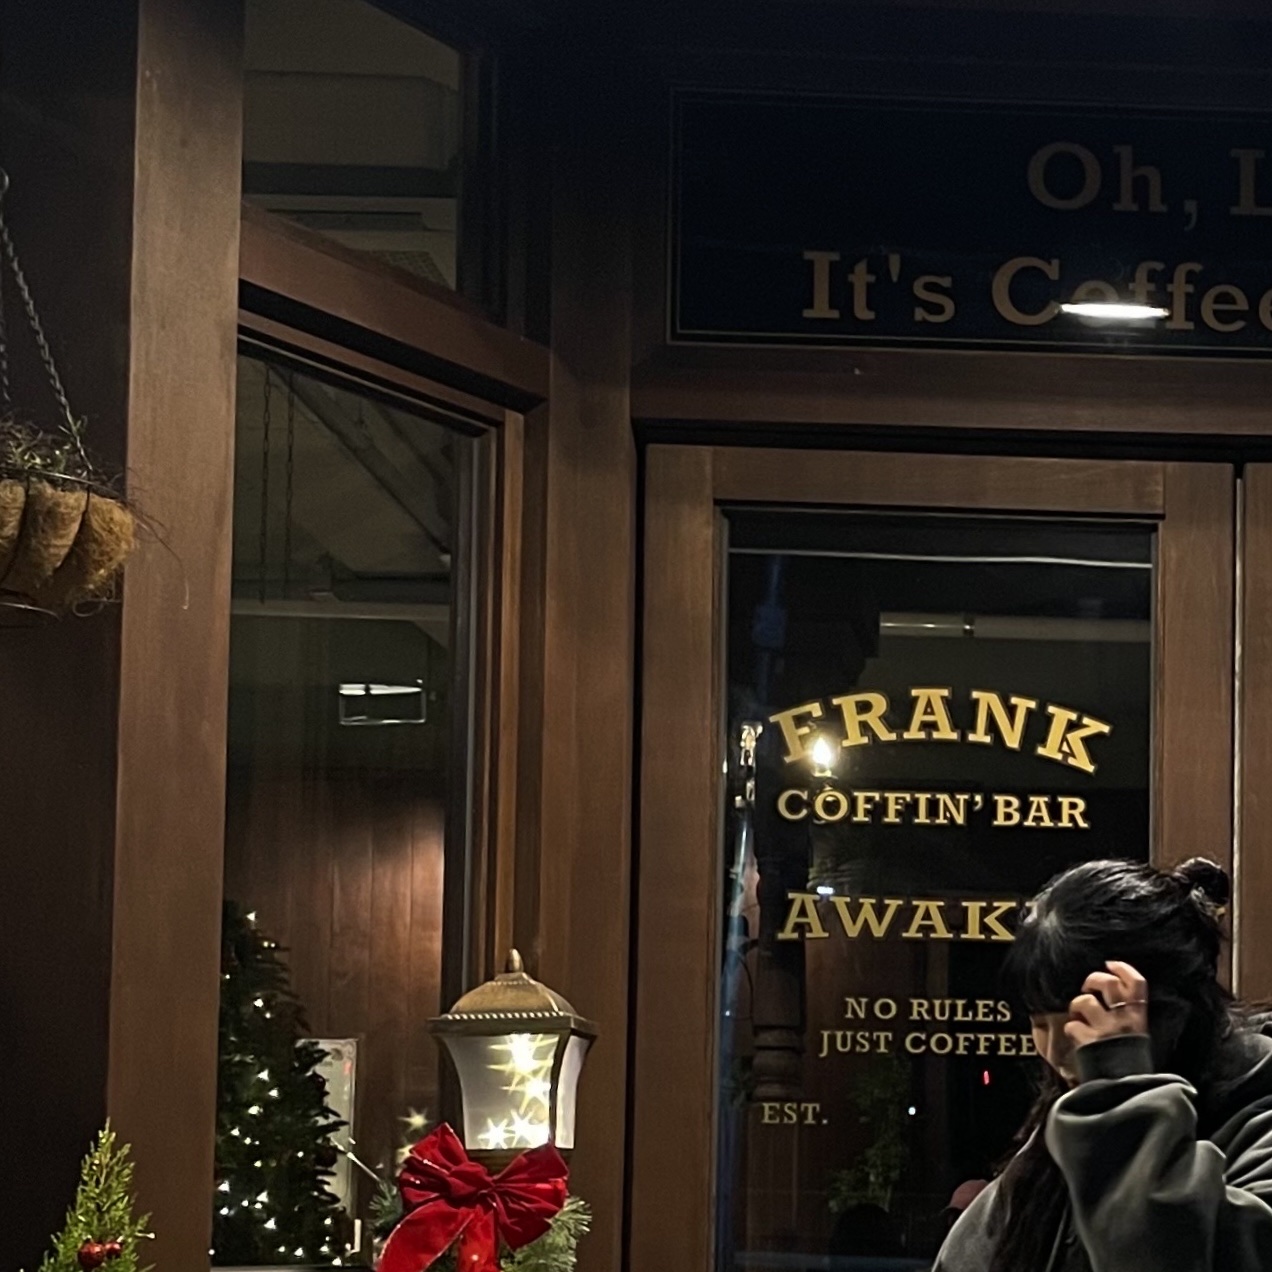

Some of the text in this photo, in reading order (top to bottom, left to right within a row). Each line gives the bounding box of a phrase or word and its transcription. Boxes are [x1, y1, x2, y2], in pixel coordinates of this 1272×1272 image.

[1026, 141, 1200, 231] Oh,
[801, 249, 957, 326] It's
[769, 687, 1111, 774] FRANK
[818, 1030, 1039, 1058] JUST COFFEE
[844, 997, 1012, 1022] NO RULES
